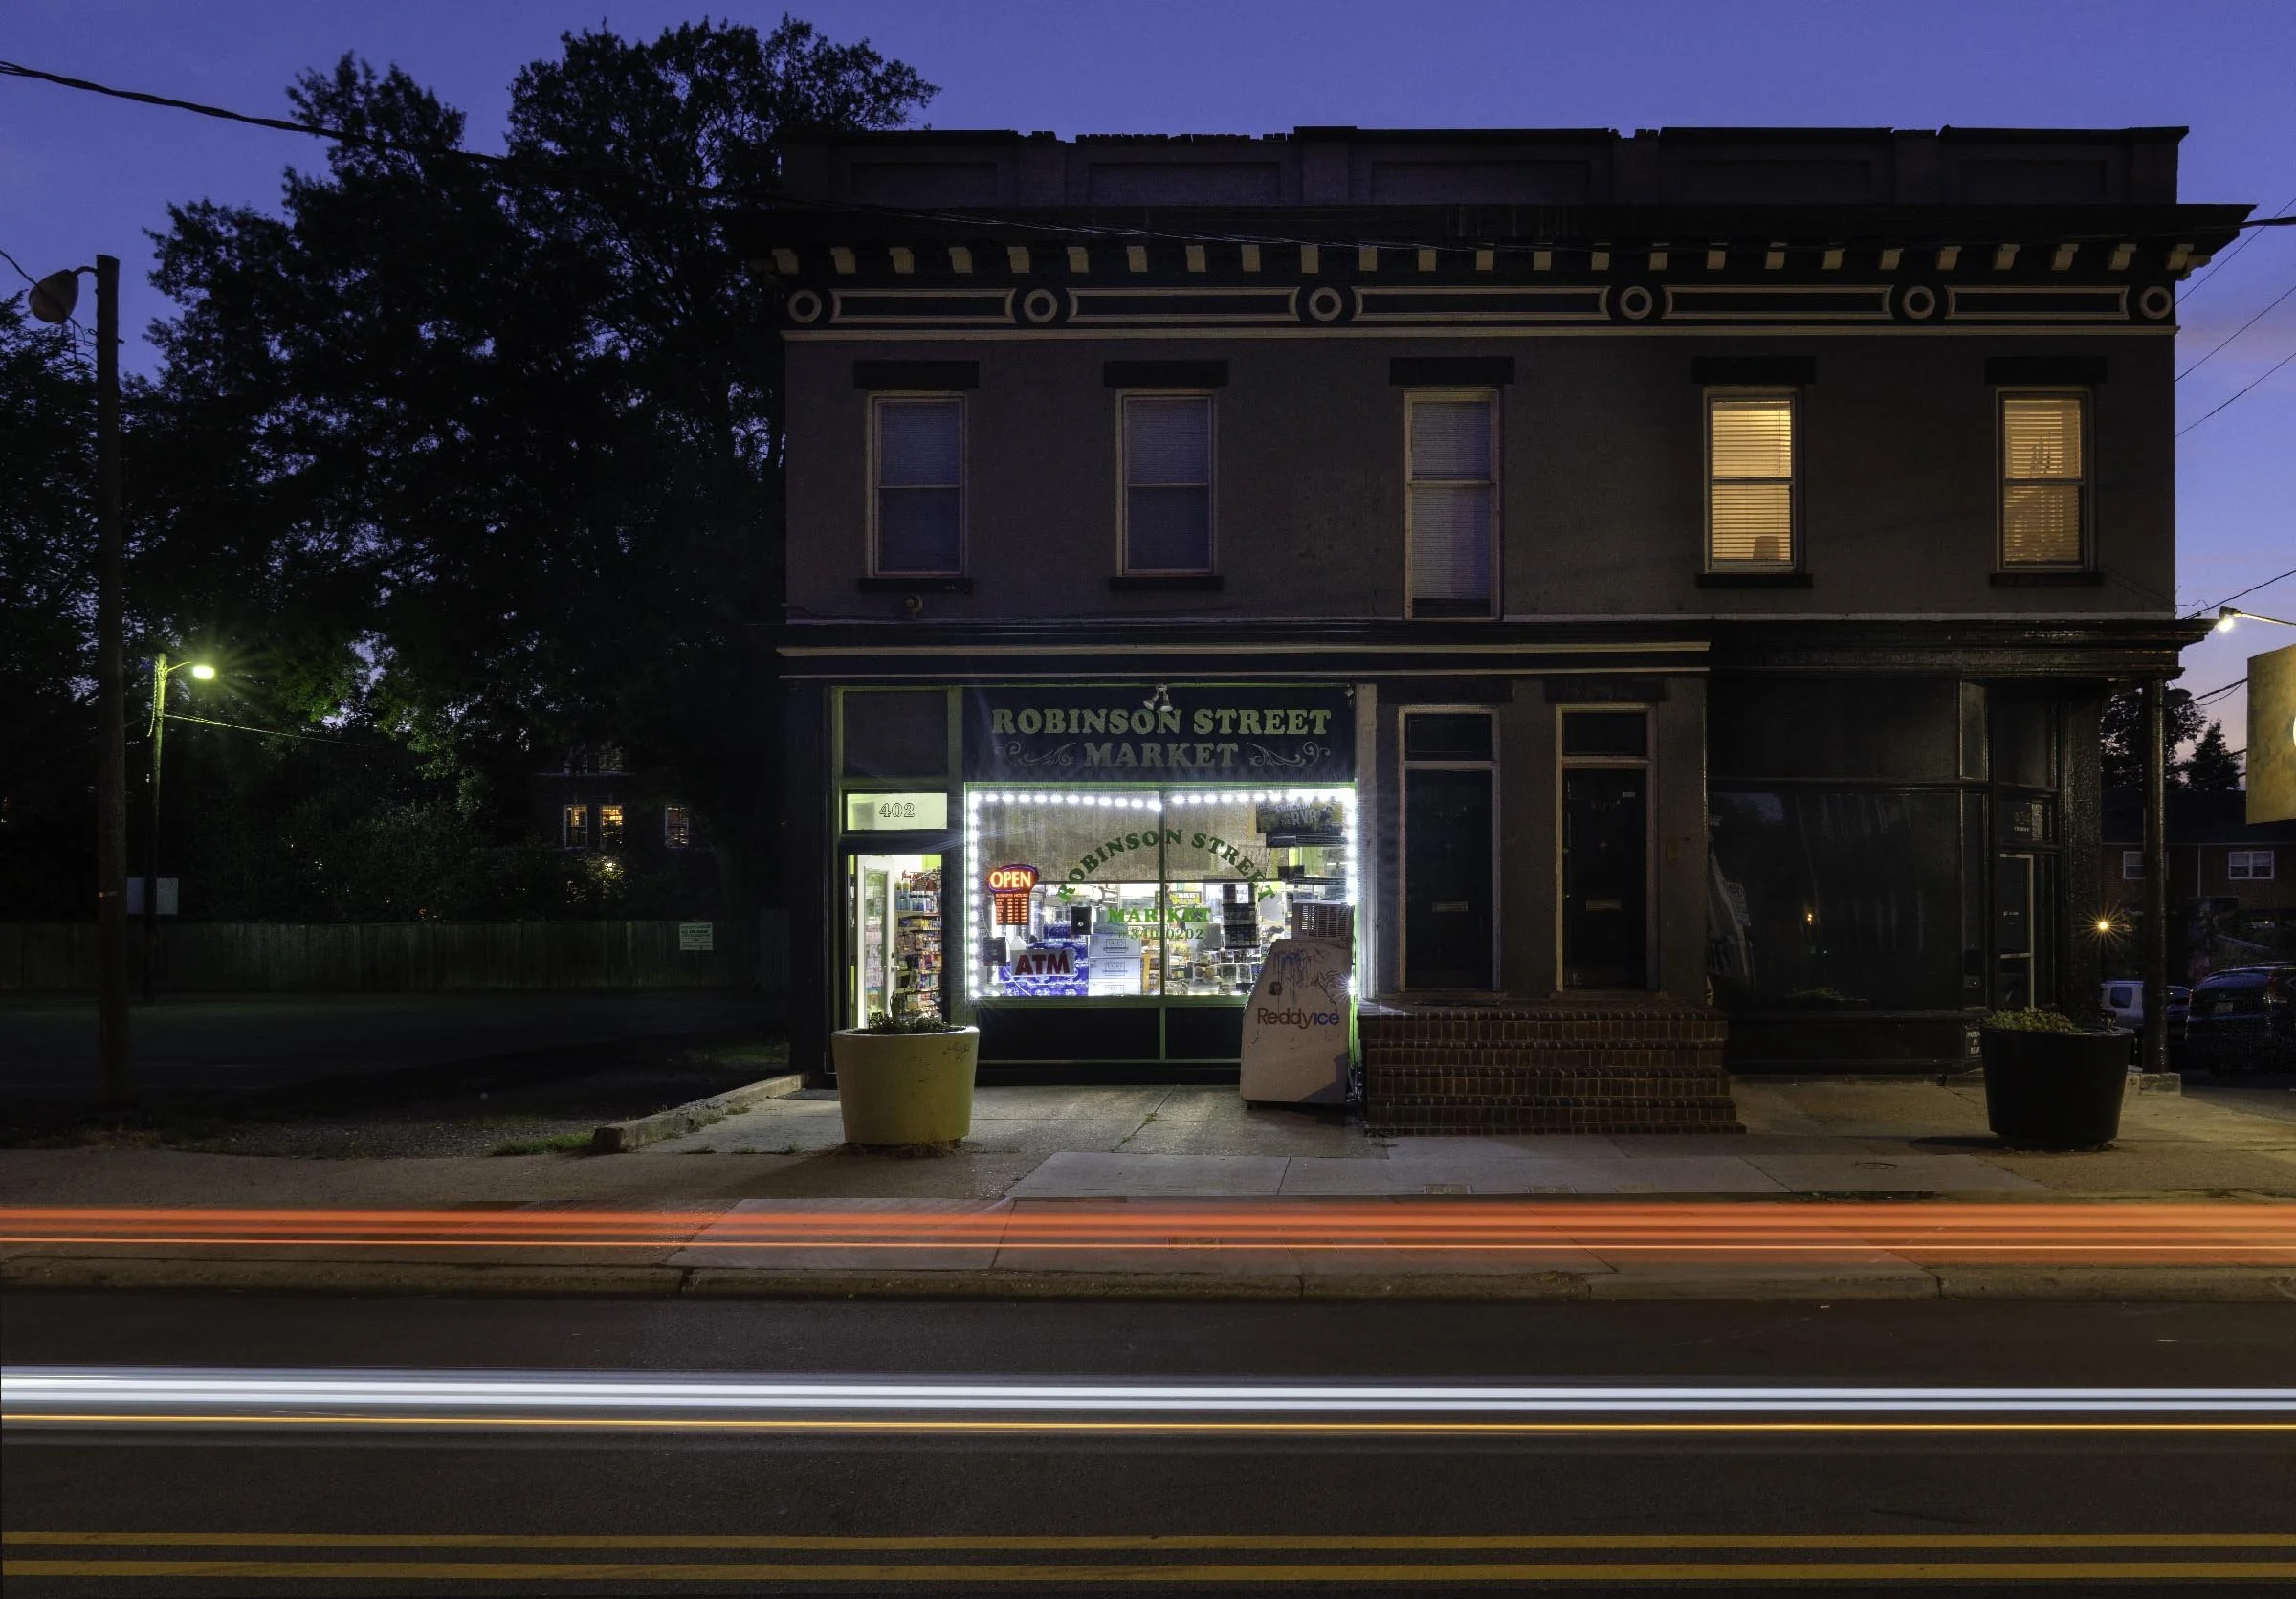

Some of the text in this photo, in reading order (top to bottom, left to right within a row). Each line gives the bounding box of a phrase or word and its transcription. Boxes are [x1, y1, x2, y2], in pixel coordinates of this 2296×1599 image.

[991, 708, 1332, 735] ROBINSON STREET
[1083, 742, 1239, 767] MARKET
[878, 802, 916, 818] 402
[1056, 829, 1276, 902] ROBINSON STREET
[989, 871, 1031, 888] OPEN
[1108, 907, 1212, 923] MARKET
[1014, 952, 1071, 976] ATM
